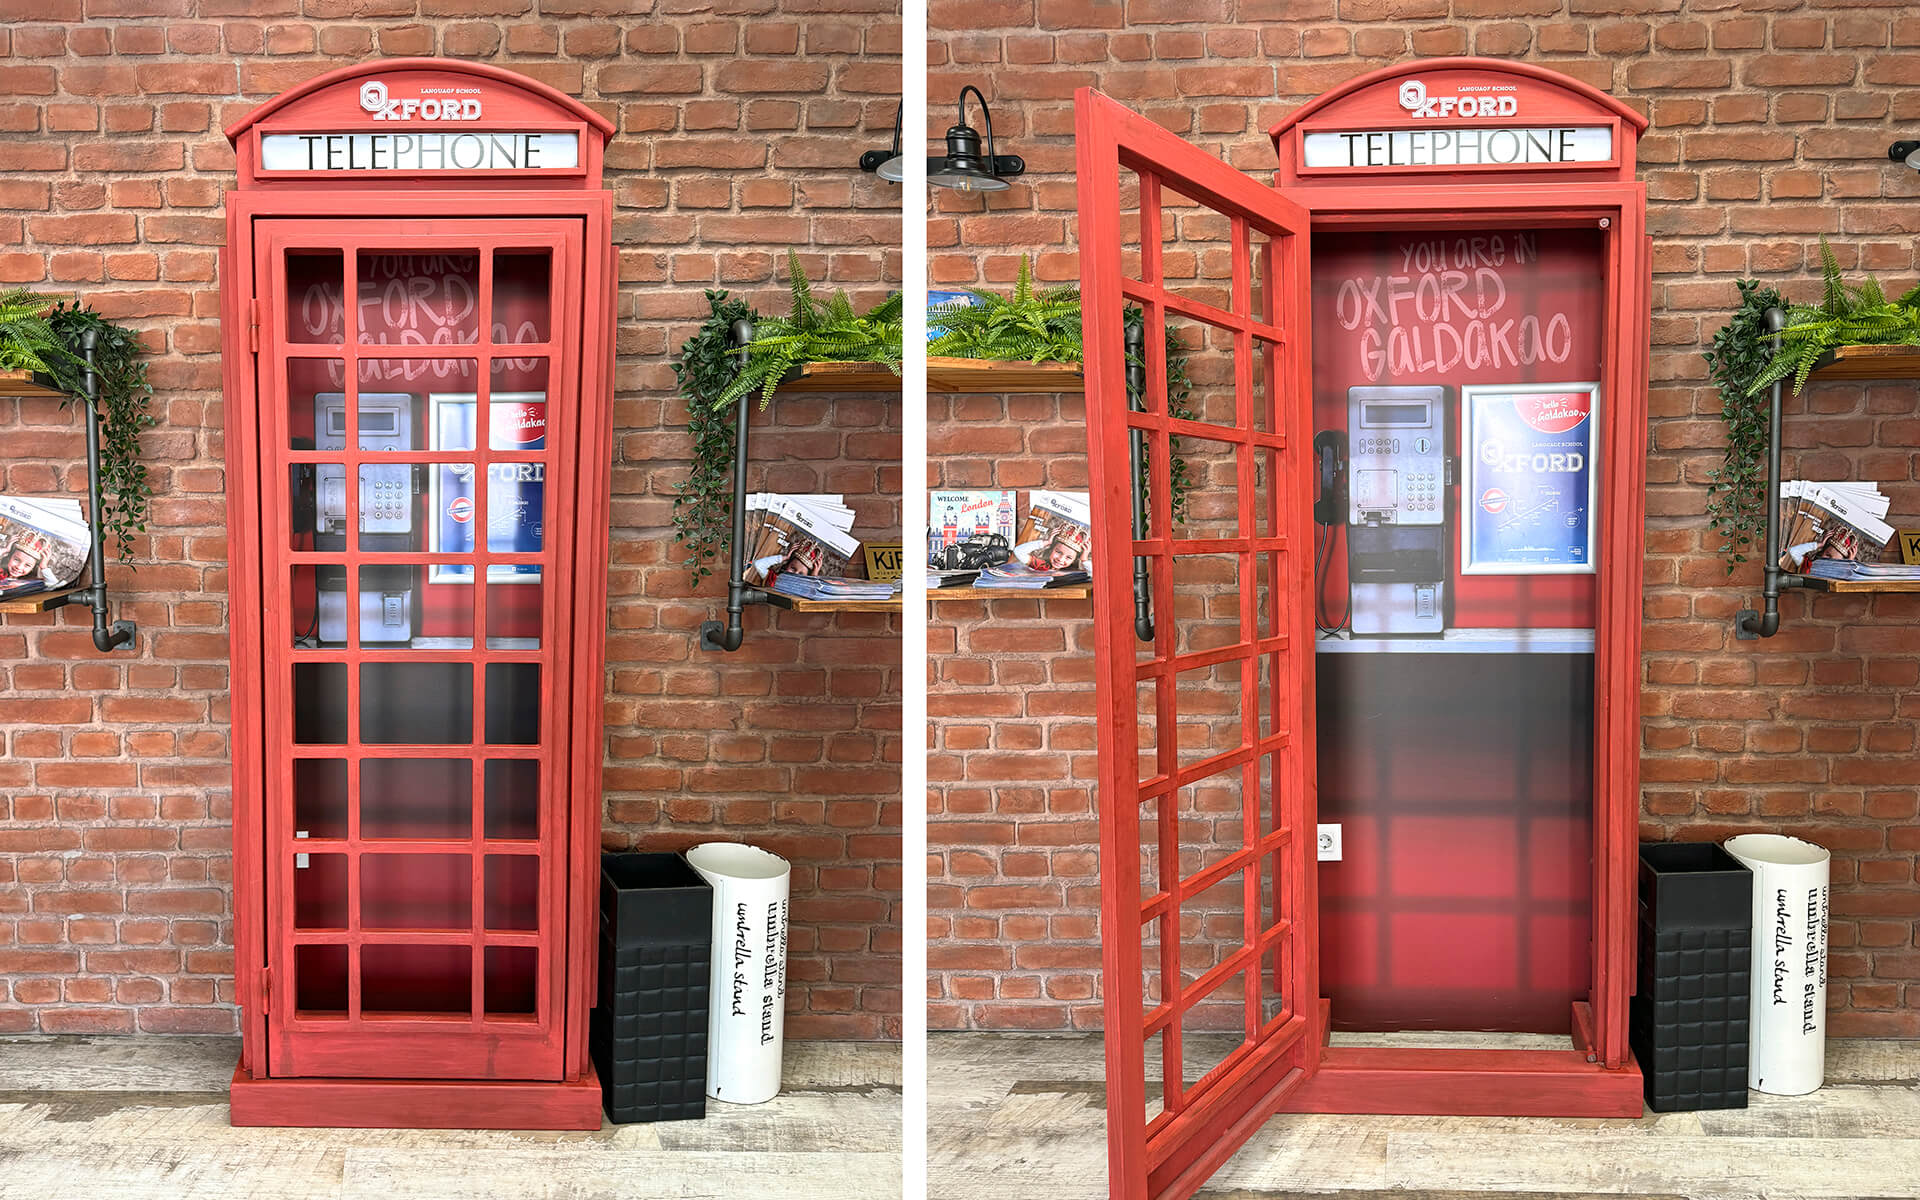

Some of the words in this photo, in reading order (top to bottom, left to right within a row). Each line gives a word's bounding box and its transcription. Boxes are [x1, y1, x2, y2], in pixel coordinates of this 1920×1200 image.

[299, 134, 542, 170] TELEPHONE
[1340, 129, 1576, 167] TELEPHONE
[302, 274, 475, 336] OXFORD
[1336, 267, 1506, 330] OXFORD
[960, 498, 994, 513] London
[736, 903, 751, 968] umbrella
[764, 902, 778, 988] umbrella
[1775, 889, 1792, 958] umbrella
[1805, 888, 1819, 977] umbrella
[732, 970, 748, 1016] stand
[1773, 958, 1790, 1006] stand
[761, 994, 775, 1045] stand
[1803, 983, 1817, 1036] stand
